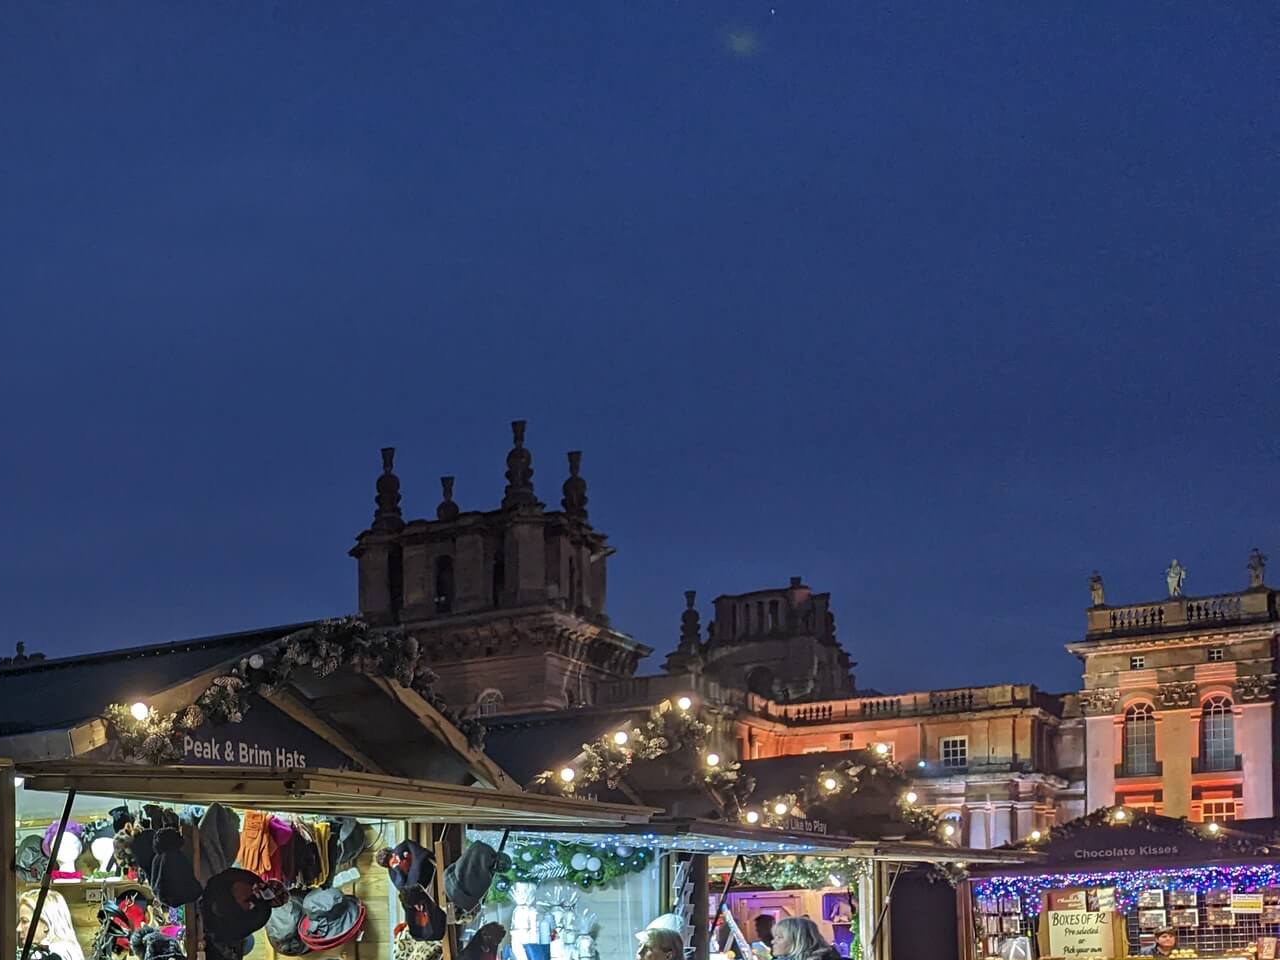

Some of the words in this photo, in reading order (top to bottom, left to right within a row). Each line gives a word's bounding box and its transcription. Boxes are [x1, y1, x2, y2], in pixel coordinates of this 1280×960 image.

[184, 735, 220, 760] Peak
[224, 740, 235, 762] &
[239, 742, 271, 766] Brim
[276, 747, 306, 768] Hats
[790, 818, 804, 831] Like
[805, 820, 813, 831] to
[813, 820, 827, 836] Play
[1074, 847, 1136, 859] Chocolate
[1139, 845, 1179, 856] Kisses
[1052, 912, 1080, 926] BOXES
[1081, 913, 1093, 925] OF
[1064, 945, 1075, 955] Pick
[1076, 947, 1090, 957] your
